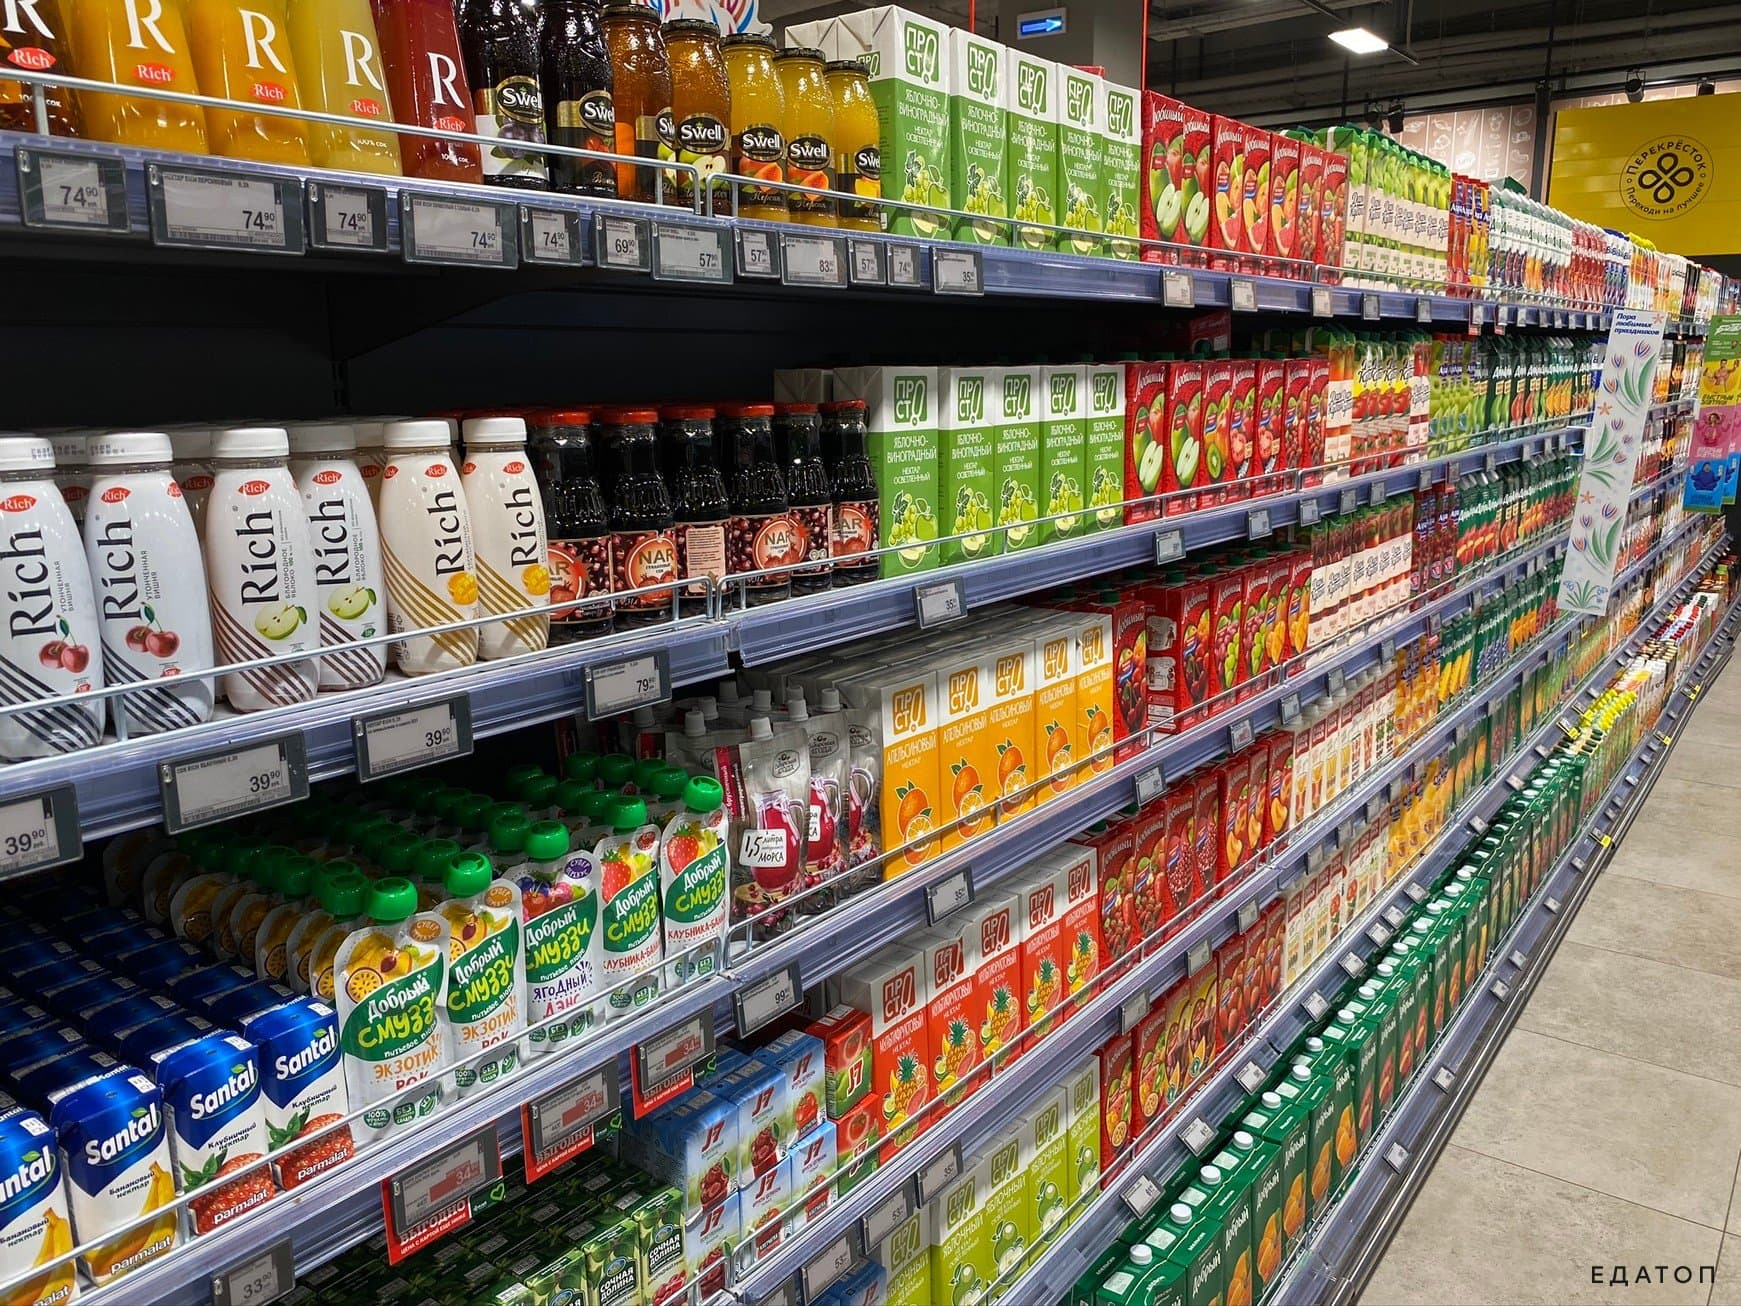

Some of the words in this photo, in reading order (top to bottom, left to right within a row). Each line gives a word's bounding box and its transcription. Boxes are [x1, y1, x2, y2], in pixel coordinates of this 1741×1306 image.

[125, 0, 176, 54] R
[240, 10, 287, 73] R
[14, 49, 50, 68] Rich
[340, 30, 382, 90] R
[137, 64, 171, 81] Rich
[427, 52, 464, 108] R
[254, 84, 284, 101] Rich
[353, 100, 381, 115] Rich
[440, 118, 463, 132] Rich
[681, 125, 722, 140] Swell
[743, 133, 780, 149] Swell
[790, 143, 826, 158] Swell
[1626, 140, 1706, 175] ПЕРЕКРЁСТОК
[60, 186, 85, 207] 74
[1626, 187, 1661, 215] Переходи
[1676, 183, 1704, 211] лучшее
[243, 210, 264, 231] 74
[264, 212, 275, 222] 90
[338, 212, 356, 230] 74
[356, 213, 367, 222] 90
[471, 231, 487, 249] 74
[543, 232, 557, 247] 74
[615, 239, 629, 252] 69
[699, 253, 712, 267] 57
[751, 249, 762, 263] 57
[819, 260, 829, 272] 83
[861, 258, 871, 270] 57
[898, 262, 907, 273] 74
[887, 448, 937, 464] ВИНОГРАДНЫЙ
[316, 474, 340, 483] Rich
[428, 467, 447, 477] Rich
[506, 464, 525, 473] Rich
[103, 489, 127, 502] Rich
[241, 482, 267, 494] Rich
[5, 498, 32, 510] Rich
[427, 489, 465, 576] Rich
[504, 487, 539, 568] Rich
[309, 499, 351, 585] Rich
[235, 509, 280, 606] Rich
[639, 549, 674, 566] NAR
[96, 518, 142, 621] Rich
[0, 527, 57, 640] Rich
[945, 599, 954, 610] 35
[636, 679, 649, 693] 79
[425, 730, 443, 747] 39
[442, 728, 451, 736] 90
[250, 774, 270, 792] 39
[270, 770, 280, 779] 90
[4, 833, 32, 856] 39
[31, 828, 45, 839] 90
[745, 835, 762, 858] 1,5
[758, 852, 784, 862] МОРСА
[683, 852, 722, 891] Добрый
[615, 875, 654, 921] Добрый
[525, 906, 578, 949] Добрый
[455, 938, 505, 986] Добрый
[533, 975, 588, 1000] ЯГОДНЫЙ
[775, 991, 786, 1004] 99
[367, 975, 431, 1023] Добрый
[462, 1007, 517, 1041] ЭКЗОТИК
[275, 1025, 336, 1079] Santal
[683, 1042, 695, 1055] 34
[375, 1046, 442, 1079] ЭКЗОТИК
[847, 1058, 864, 1097] J7
[190, 1060, 255, 1119] Santal
[292, 1084, 337, 1109] Клубничный
[584, 1097, 596, 1112] 34
[85, 1103, 158, 1165] Santal
[207, 1122, 257, 1149] Клубничный
[218, 1133, 249, 1151] нектар
[297, 1149, 347, 1180] parmalat
[456, 1166, 471, 1185] 34
[109, 1171, 155, 1195] Банановый
[117, 1180, 150, 1199] нектар
[214, 1190, 268, 1224] parmalat
[111, 1235, 172, 1275] parmalat
[650, 1235, 680, 1259] СОЧНАЯ
[650, 1242, 681, 1266] ДОЛИНА
[243, 1279, 263, 1299] 33
[263, 1271, 272, 1282] 90
[600, 1268, 634, 1294] СОЧНАЯ
[601, 1275, 634, 1300] ДОЛИНА
